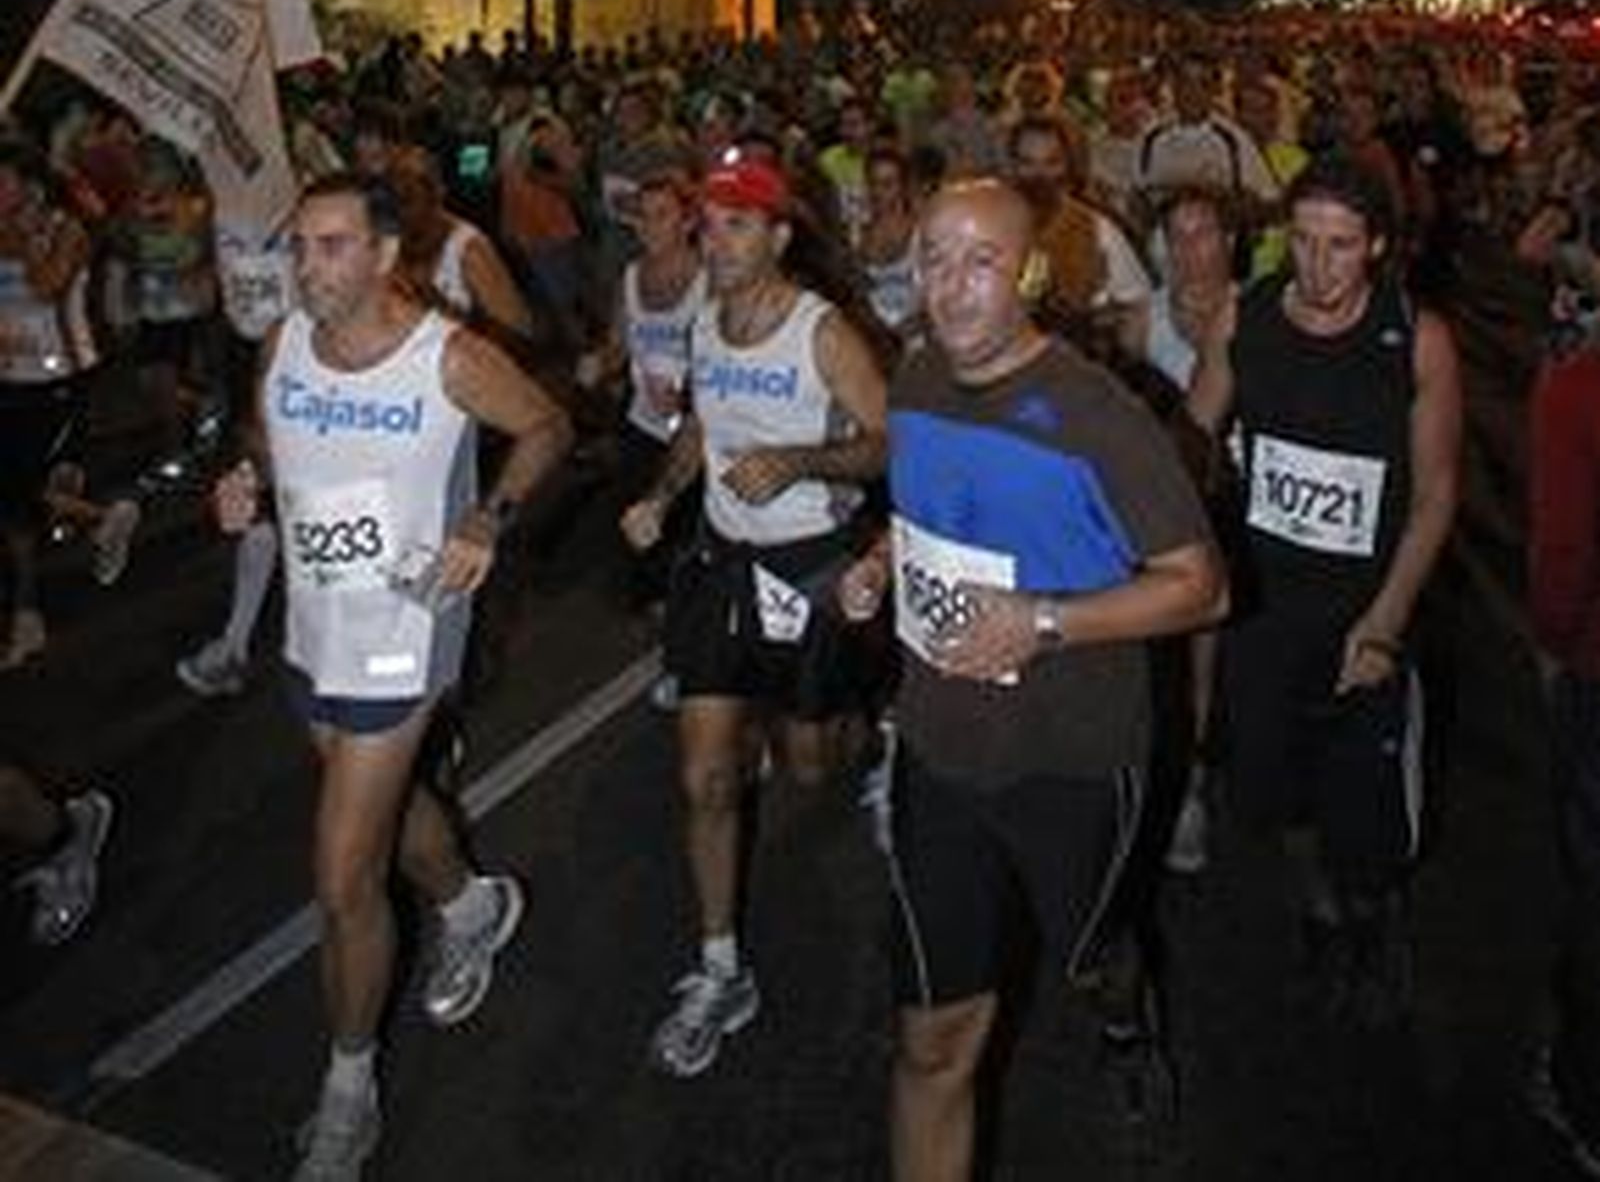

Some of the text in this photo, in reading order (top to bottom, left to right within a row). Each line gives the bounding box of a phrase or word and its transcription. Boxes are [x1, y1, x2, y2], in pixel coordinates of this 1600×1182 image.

[278, 374, 422, 435] Cajasol
[1264, 468, 1363, 529] 10721
[293, 516, 383, 564] 5233
